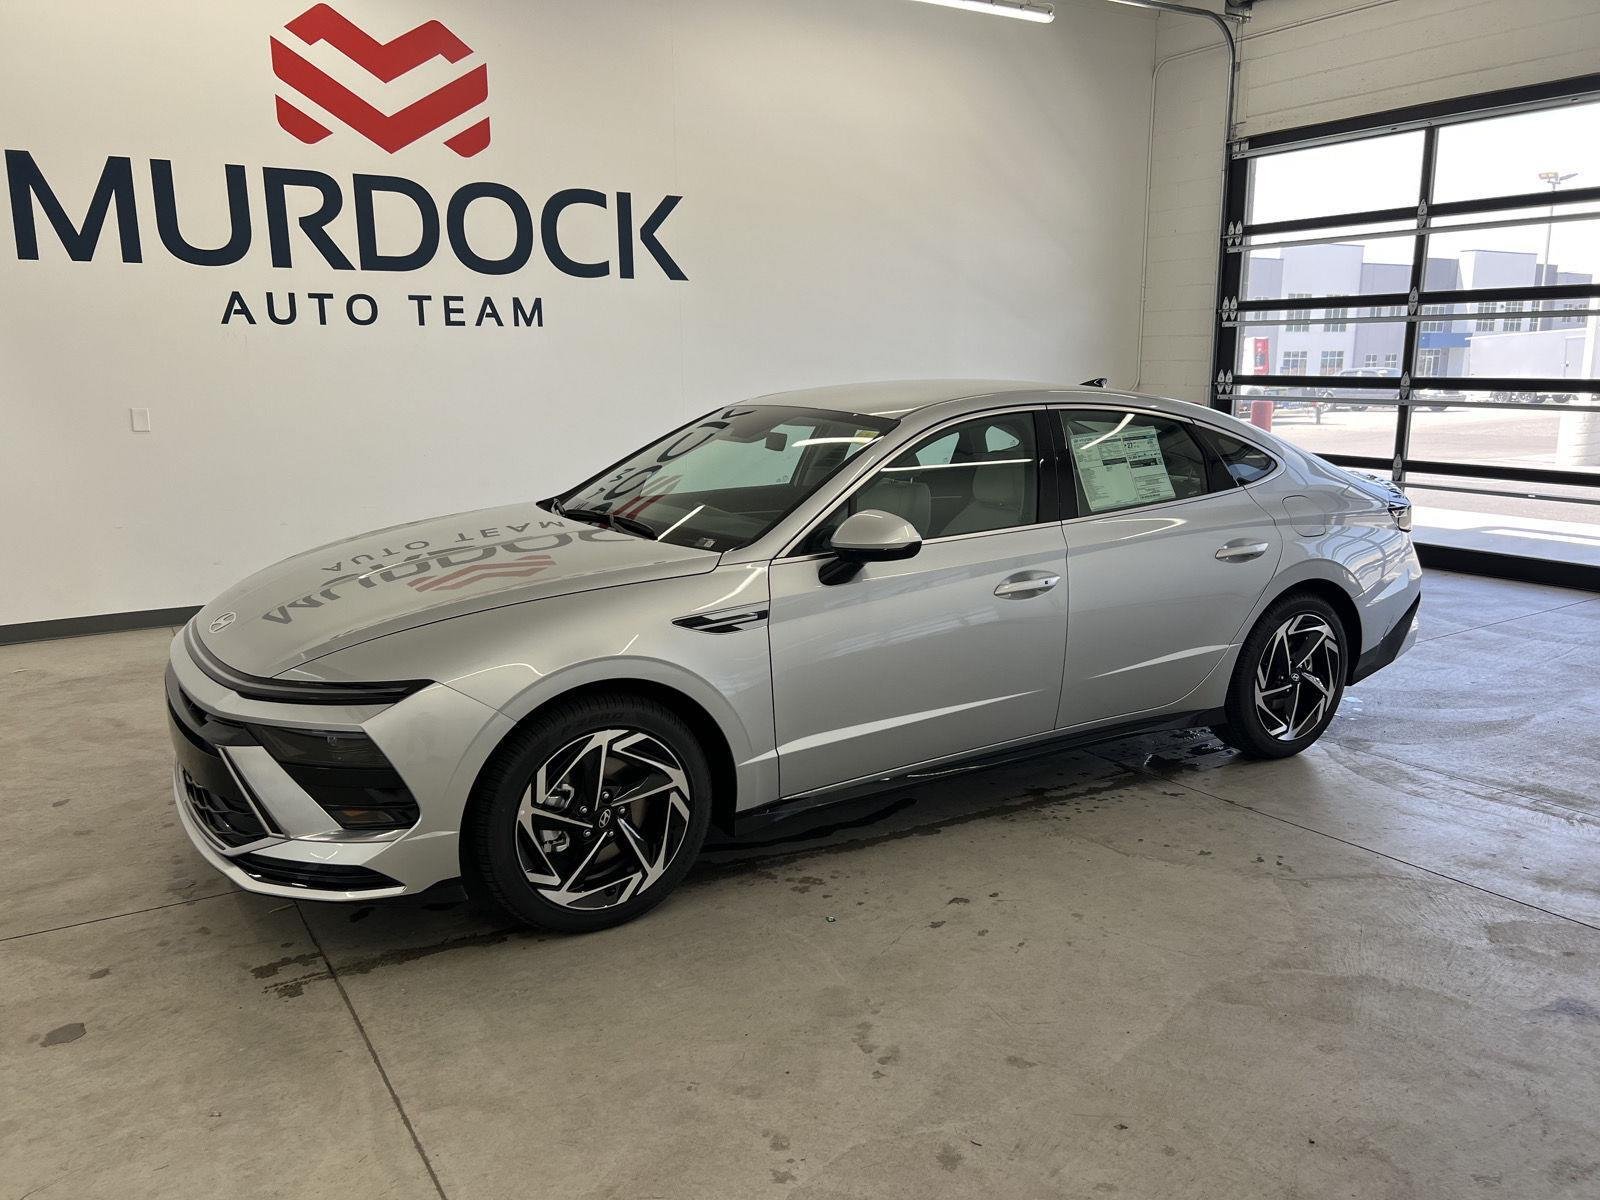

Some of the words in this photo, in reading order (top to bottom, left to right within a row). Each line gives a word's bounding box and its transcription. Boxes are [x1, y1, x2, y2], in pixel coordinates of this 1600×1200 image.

[5, 149, 690, 281] MURDOCK
[221, 290, 380, 326] AUTO
[407, 294, 545, 328] TEAM
